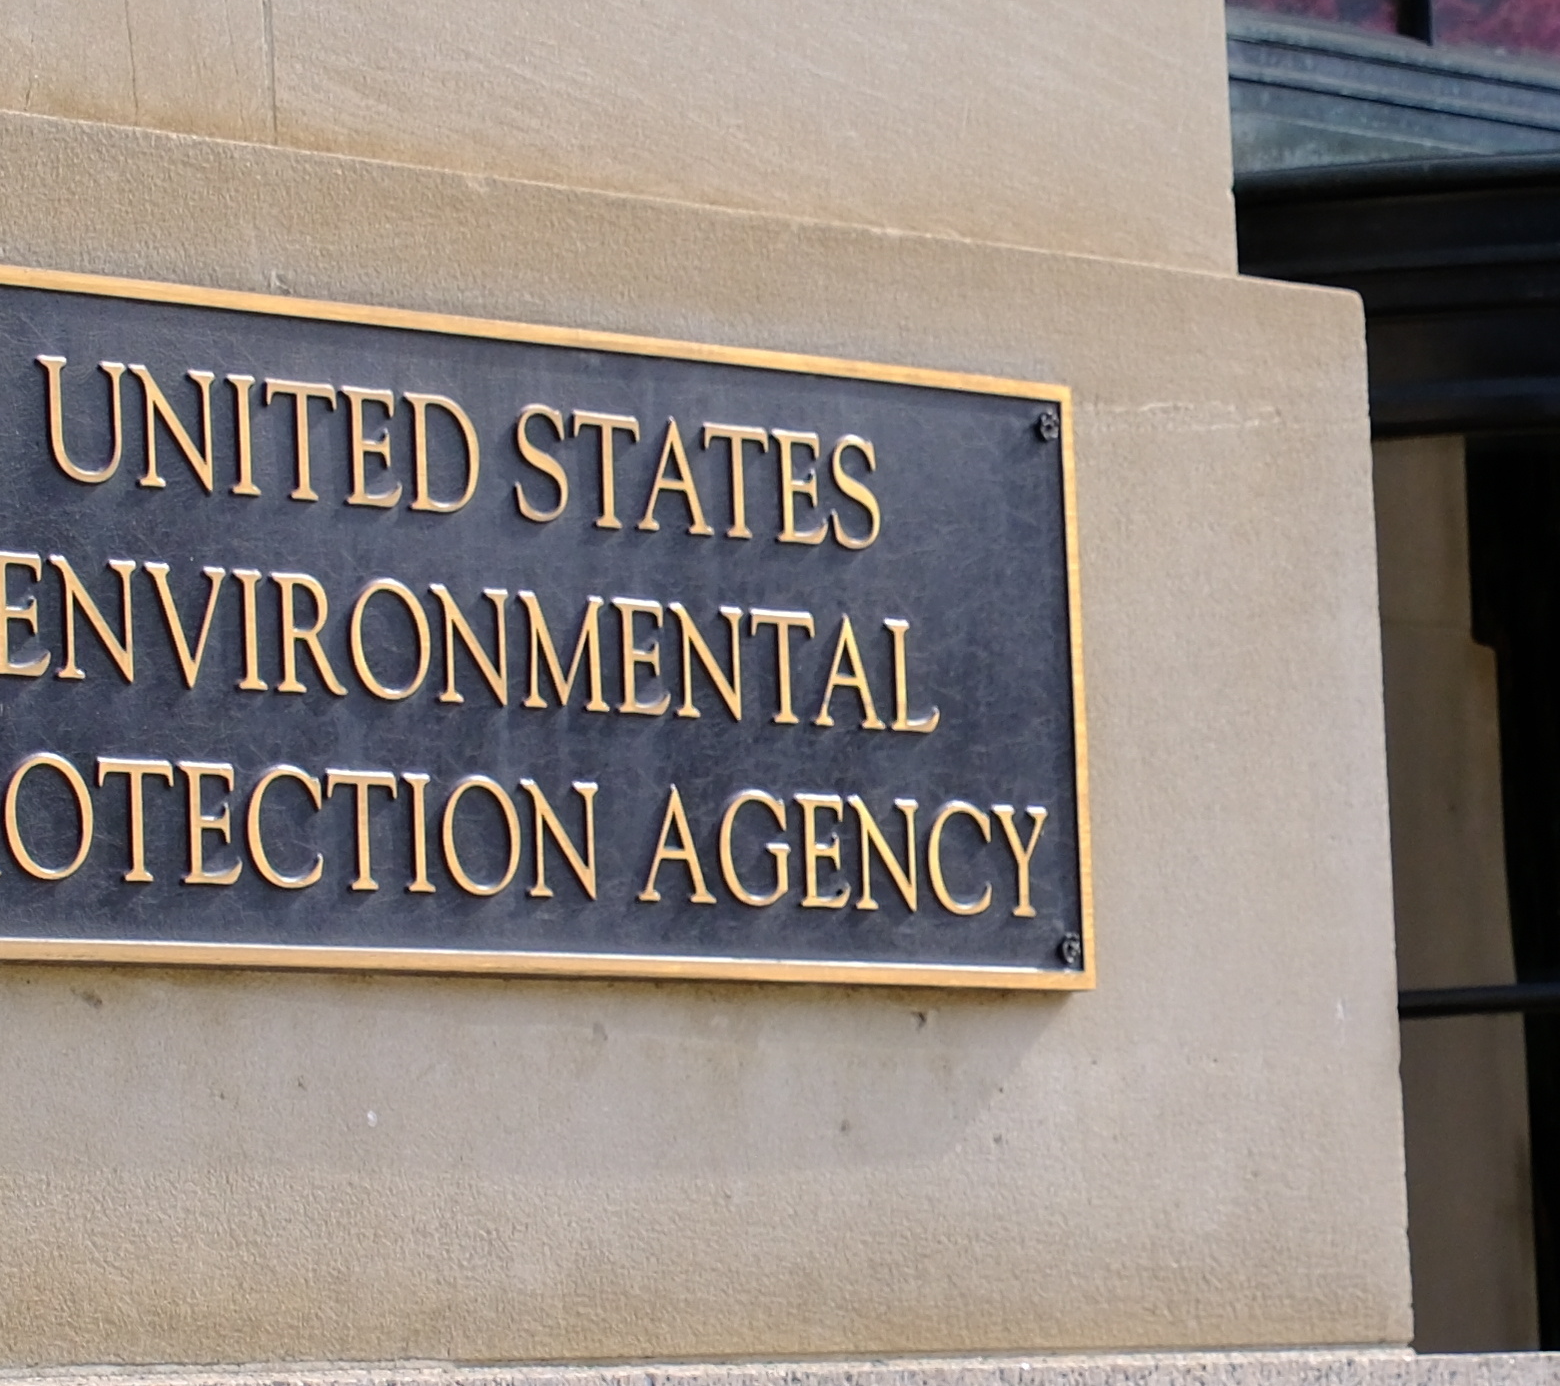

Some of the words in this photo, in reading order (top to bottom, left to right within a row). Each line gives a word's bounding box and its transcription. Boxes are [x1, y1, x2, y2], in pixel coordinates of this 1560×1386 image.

[37, 353, 482, 514] UNITED
[512, 403, 882, 550] STATES
[637, 783, 1048, 918] AGENCY
